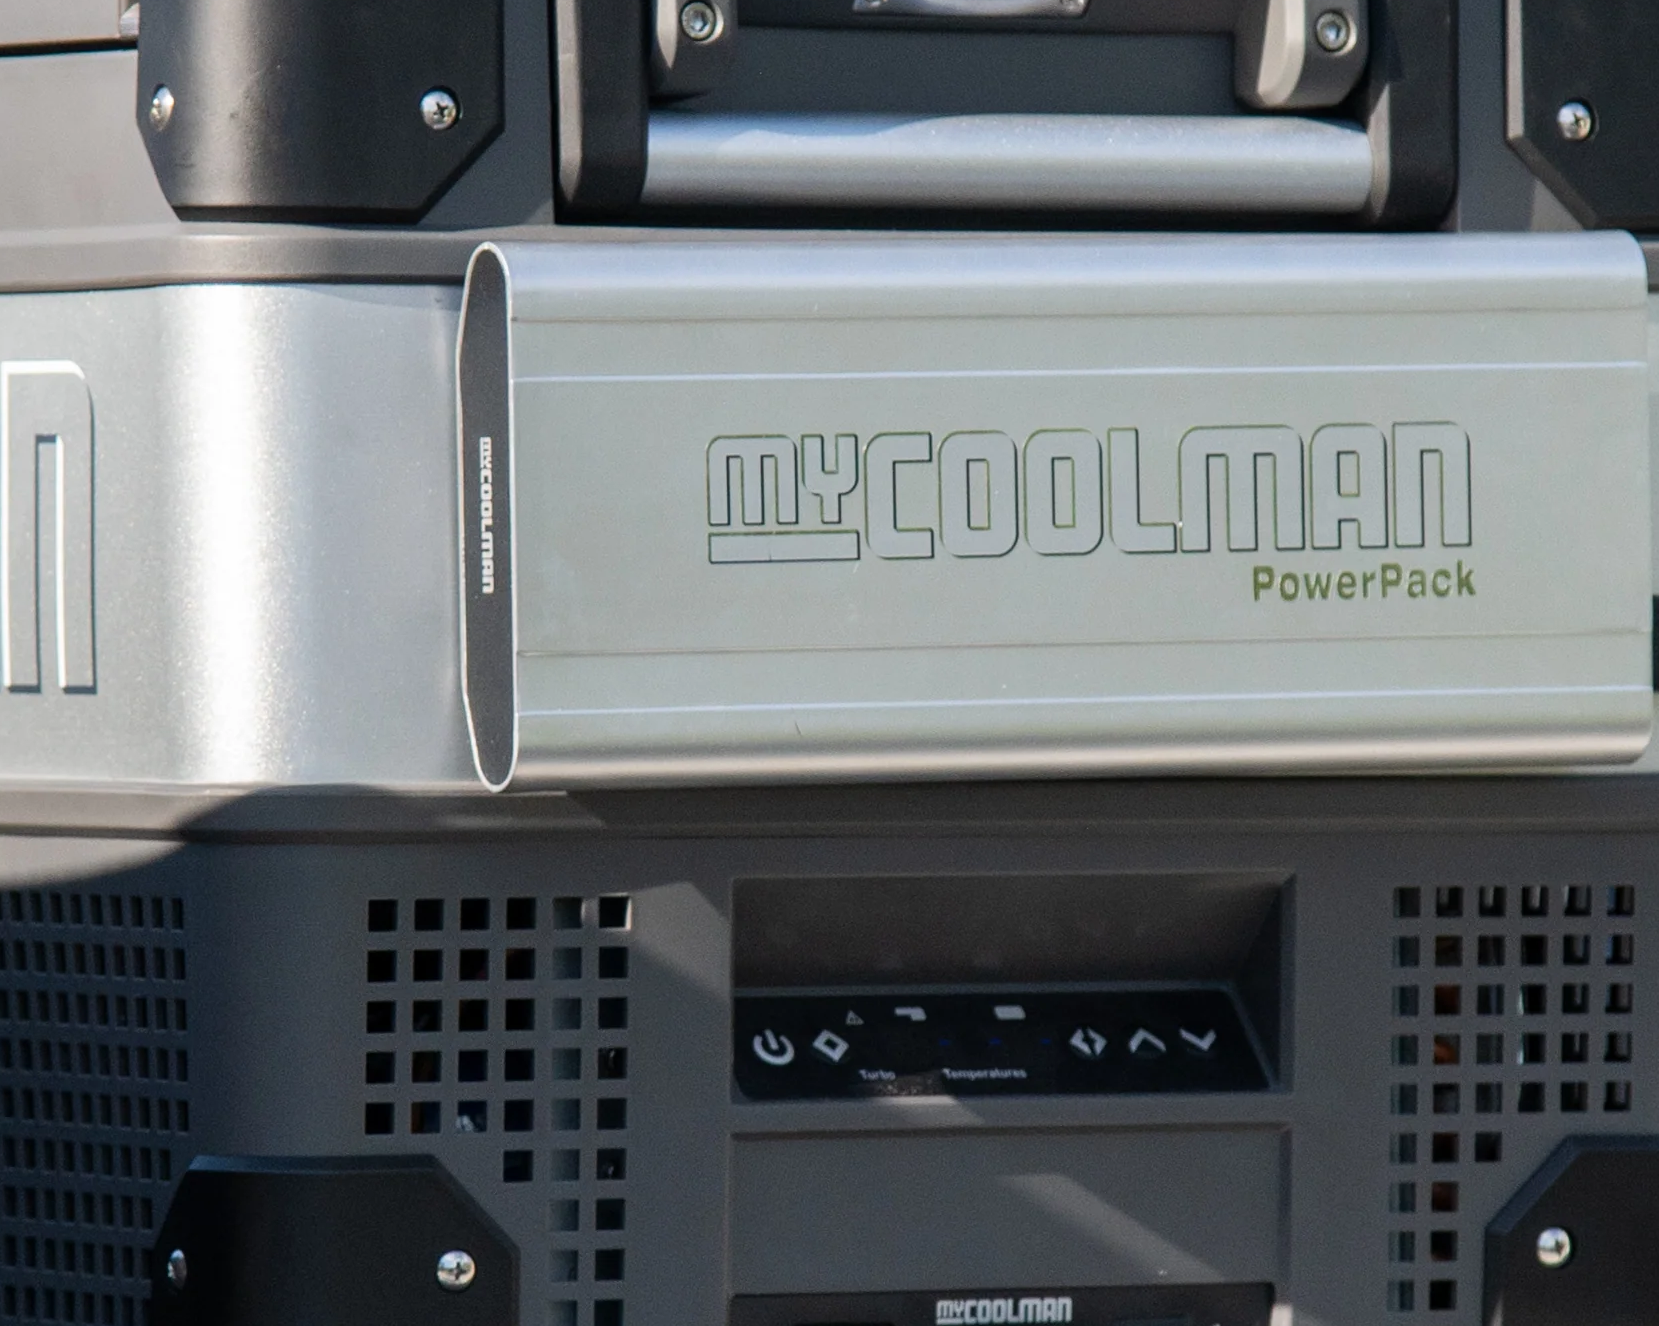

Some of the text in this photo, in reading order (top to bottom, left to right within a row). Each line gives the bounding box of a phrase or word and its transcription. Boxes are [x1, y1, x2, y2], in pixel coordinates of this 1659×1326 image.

[1253, 559, 1476, 602] PowerPack
[859, 1069, 896, 1081] Turbo
[943, 1067, 1028, 1081] Temperatures
